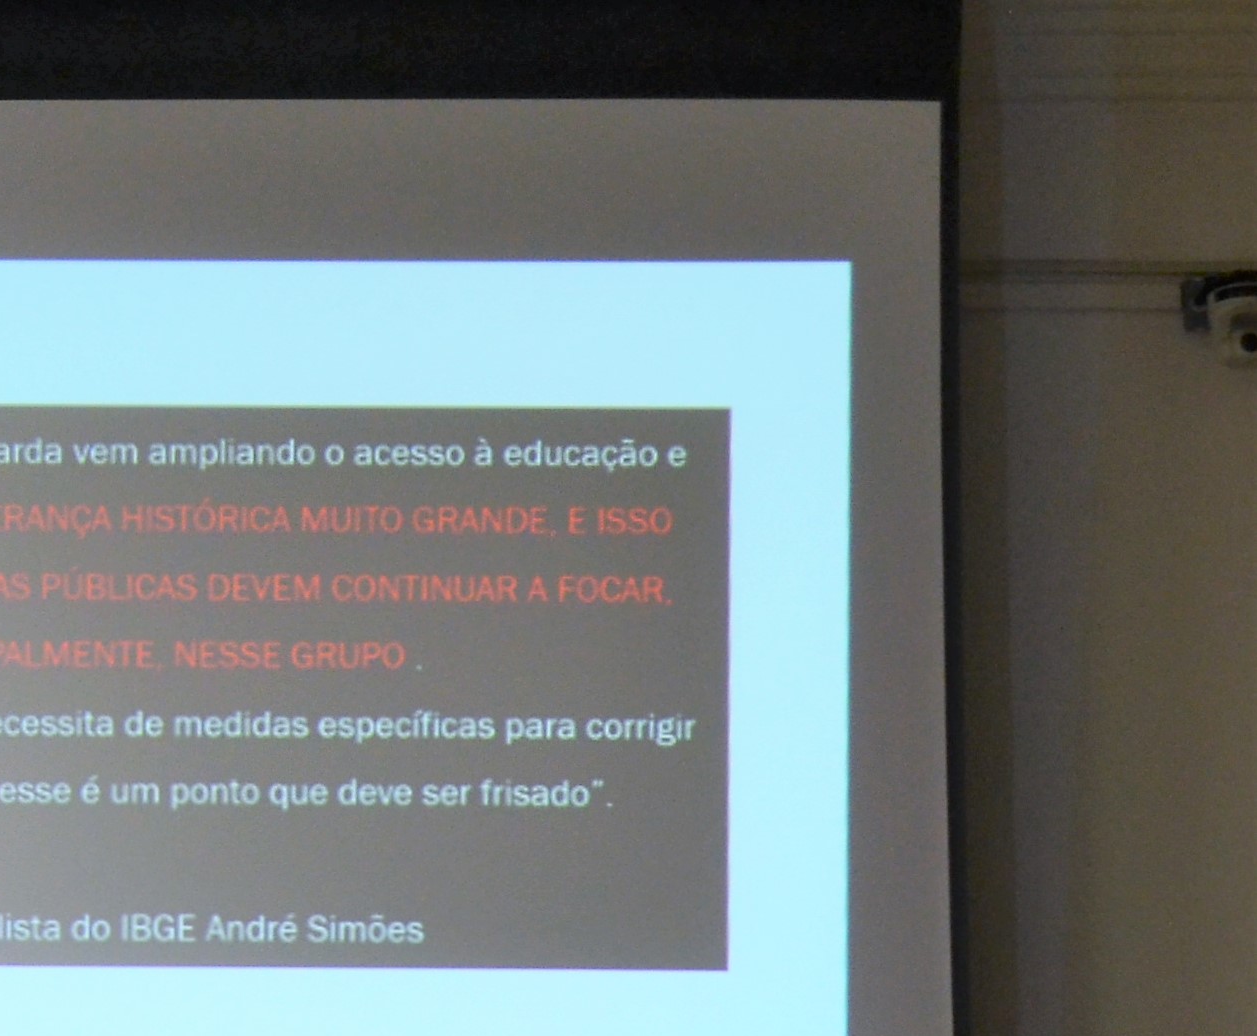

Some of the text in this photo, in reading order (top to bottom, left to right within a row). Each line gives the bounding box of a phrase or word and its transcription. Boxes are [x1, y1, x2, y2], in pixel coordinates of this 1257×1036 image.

[73, 441, 138, 465] vem
[149, 438, 315, 470] ampliando
[325, 442, 343, 466] o
[354, 442, 465, 467] acesso
[474, 438, 493, 467] à
[504, 438, 658, 472] educação
[668, 443, 687, 467] e
[122, 498, 291, 533] HISTÓRICA
[301, 506, 404, 533] MUITO
[569, 508, 585, 535] E
[598, 507, 672, 535] ISSO
[43, 567, 197, 601] PÚBLICAS
[207, 574, 321, 601] DEVEM
[331, 574, 517, 602] CONTINUAR
[527, 575, 547, 602] A
[175, 641, 281, 669] NESSE
[291, 641, 405, 670] GRUPO
[124, 710, 164, 737] de
[174, 711, 308, 739] medidas
[318, 710, 495, 743] específicas
[506, 717, 574, 744] para
[585, 714, 697, 746] corrigir
[81, 776, 101, 804] é
[111, 783, 160, 804] um
[171, 779, 259, 809] ponto
[270, 783, 329, 810] que
[338, 778, 412, 805] deve
[422, 784, 470, 806] ser
[72, 914, 111, 941] do
[121, 913, 195, 943] IBGE
[206, 914, 298, 943] André
[307, 914, 425, 943] Simões
